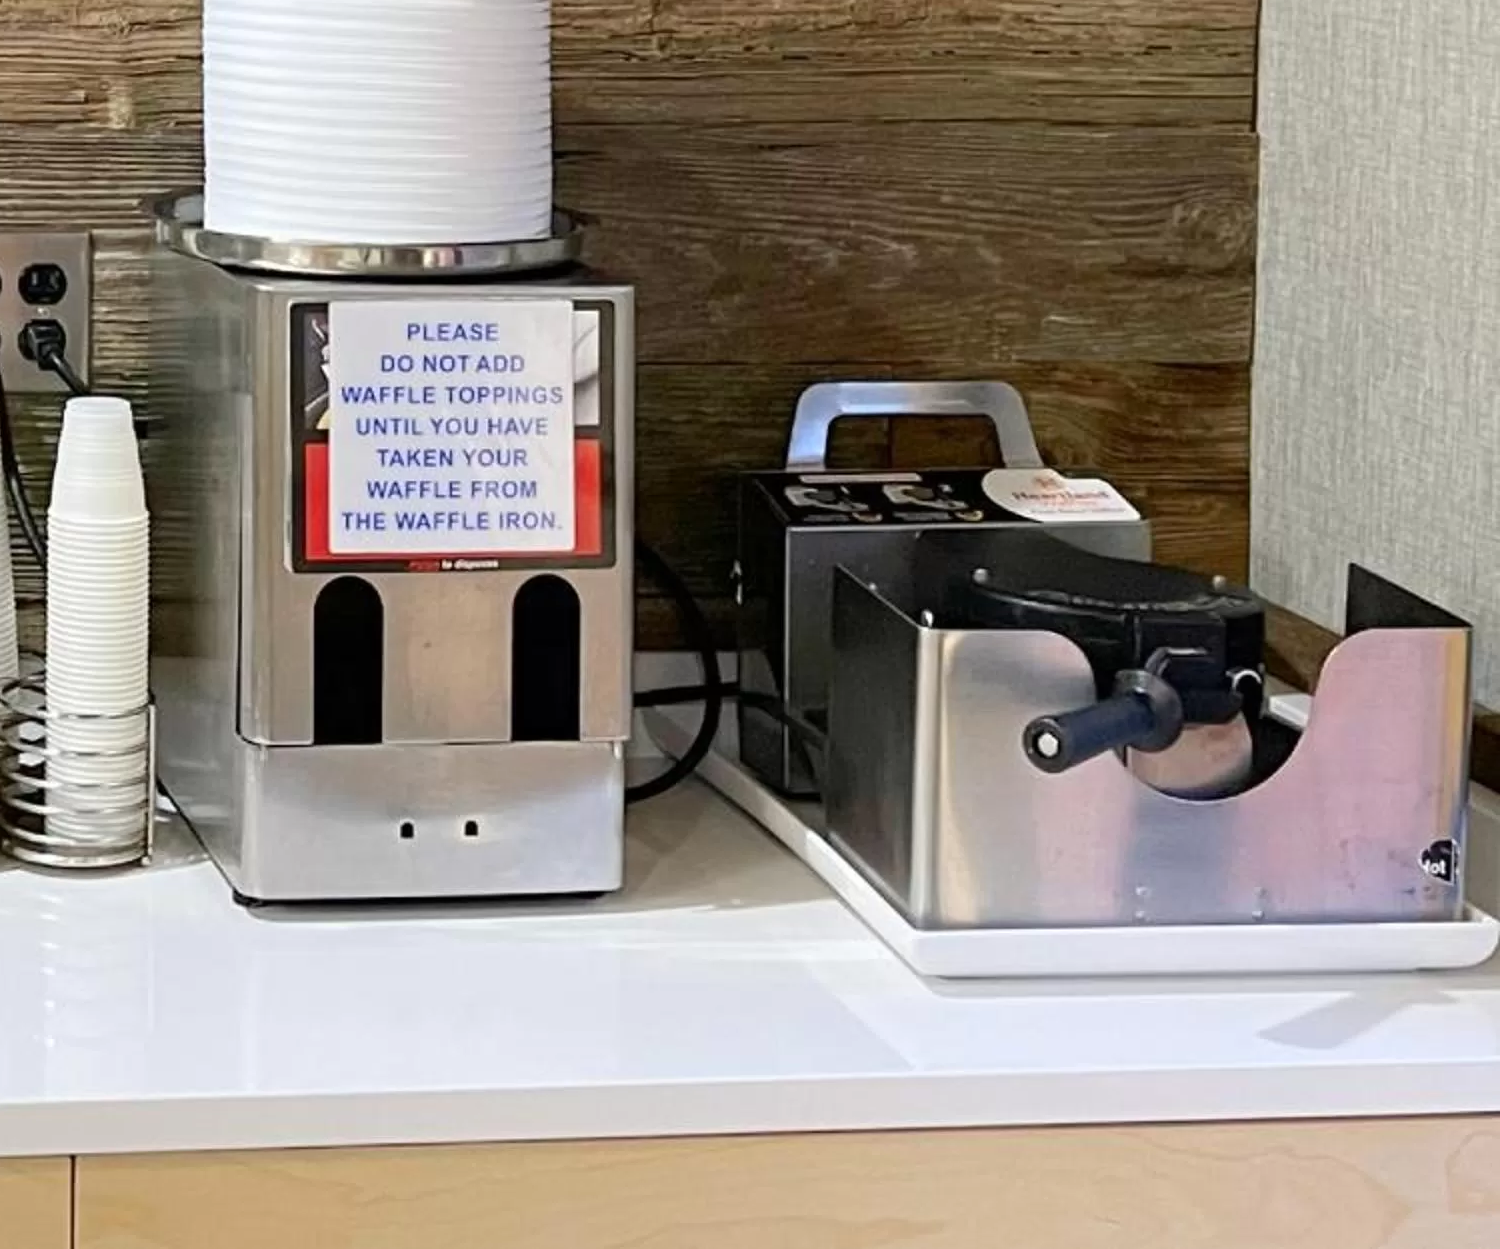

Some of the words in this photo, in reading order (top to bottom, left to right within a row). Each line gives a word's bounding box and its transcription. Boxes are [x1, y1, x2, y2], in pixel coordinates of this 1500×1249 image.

[406, 322, 499, 342] PLEASE
[380, 354, 415, 374] DO
[422, 354, 469, 374] NOT
[475, 354, 526, 373] ADD
[341, 385, 436, 405] WAFFLE
[445, 385, 564, 405] TOPPINGS
[356, 417, 424, 437] UNTIL
[430, 417, 479, 437] YOU
[487, 417, 549, 437] HAVE
[376, 448, 454, 468] TAKEN
[461, 448, 529, 468] YOUR
[366, 480, 462, 499] WAFFLE
[470, 479, 538, 499] FROM
[341, 511, 387, 531] THE
[394, 511, 490, 531] WAFFLE
[498, 511, 563, 531] IRON.
